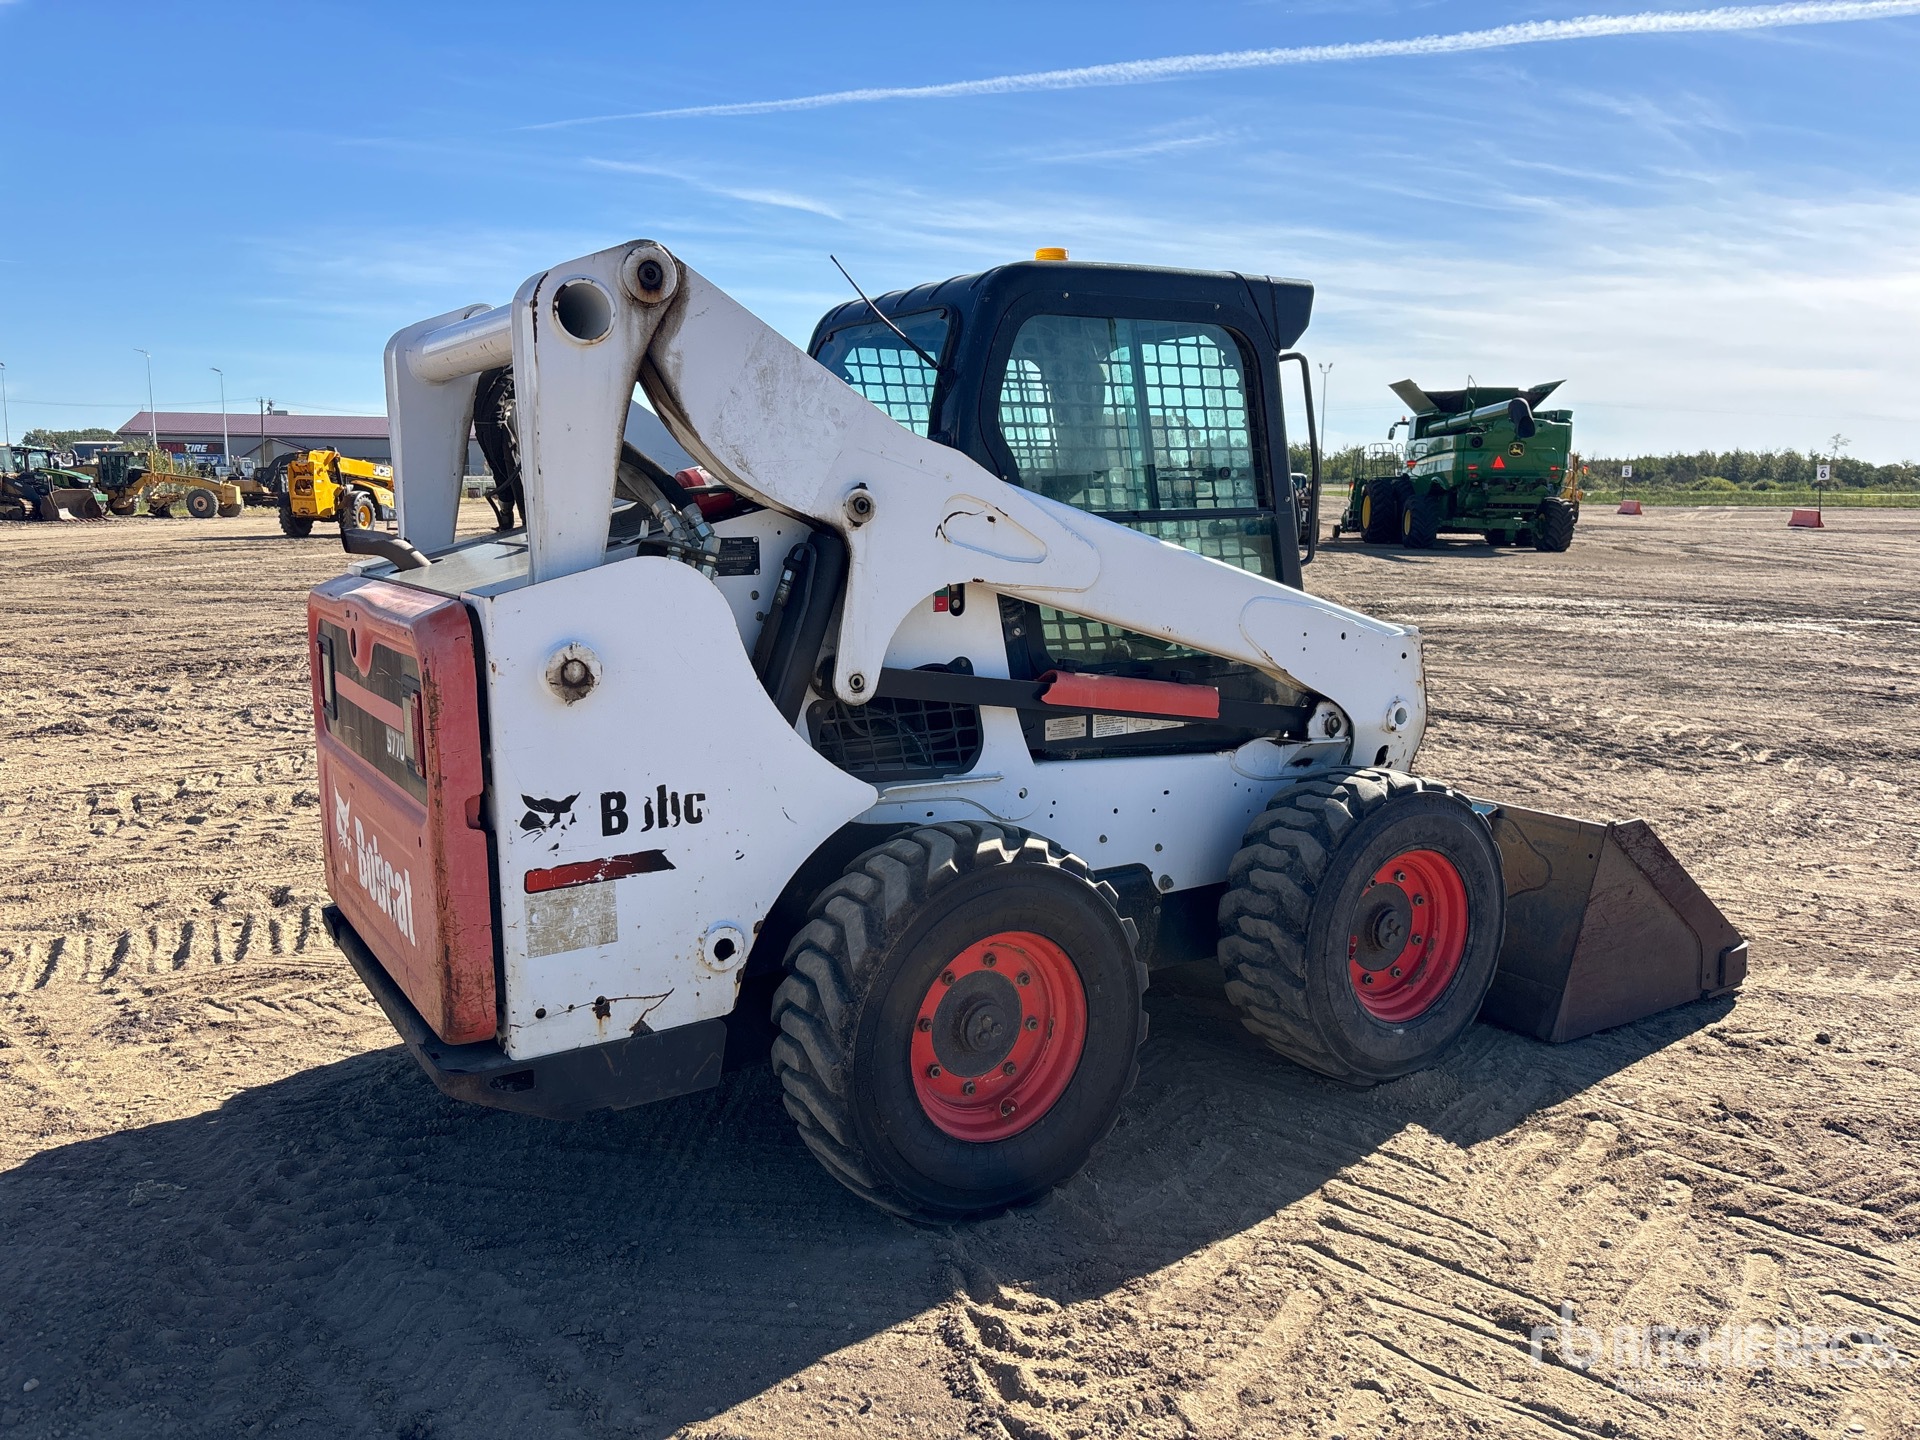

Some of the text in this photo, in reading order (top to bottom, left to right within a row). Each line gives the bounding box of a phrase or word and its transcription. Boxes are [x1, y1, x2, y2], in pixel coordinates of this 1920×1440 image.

[184, 443, 208, 453] TIRE
[373, 464, 391, 477] JCB
[1820, 470, 1827, 478] 6
[386, 725, 405, 761] S770
[355, 816, 416, 947] Bobcat
